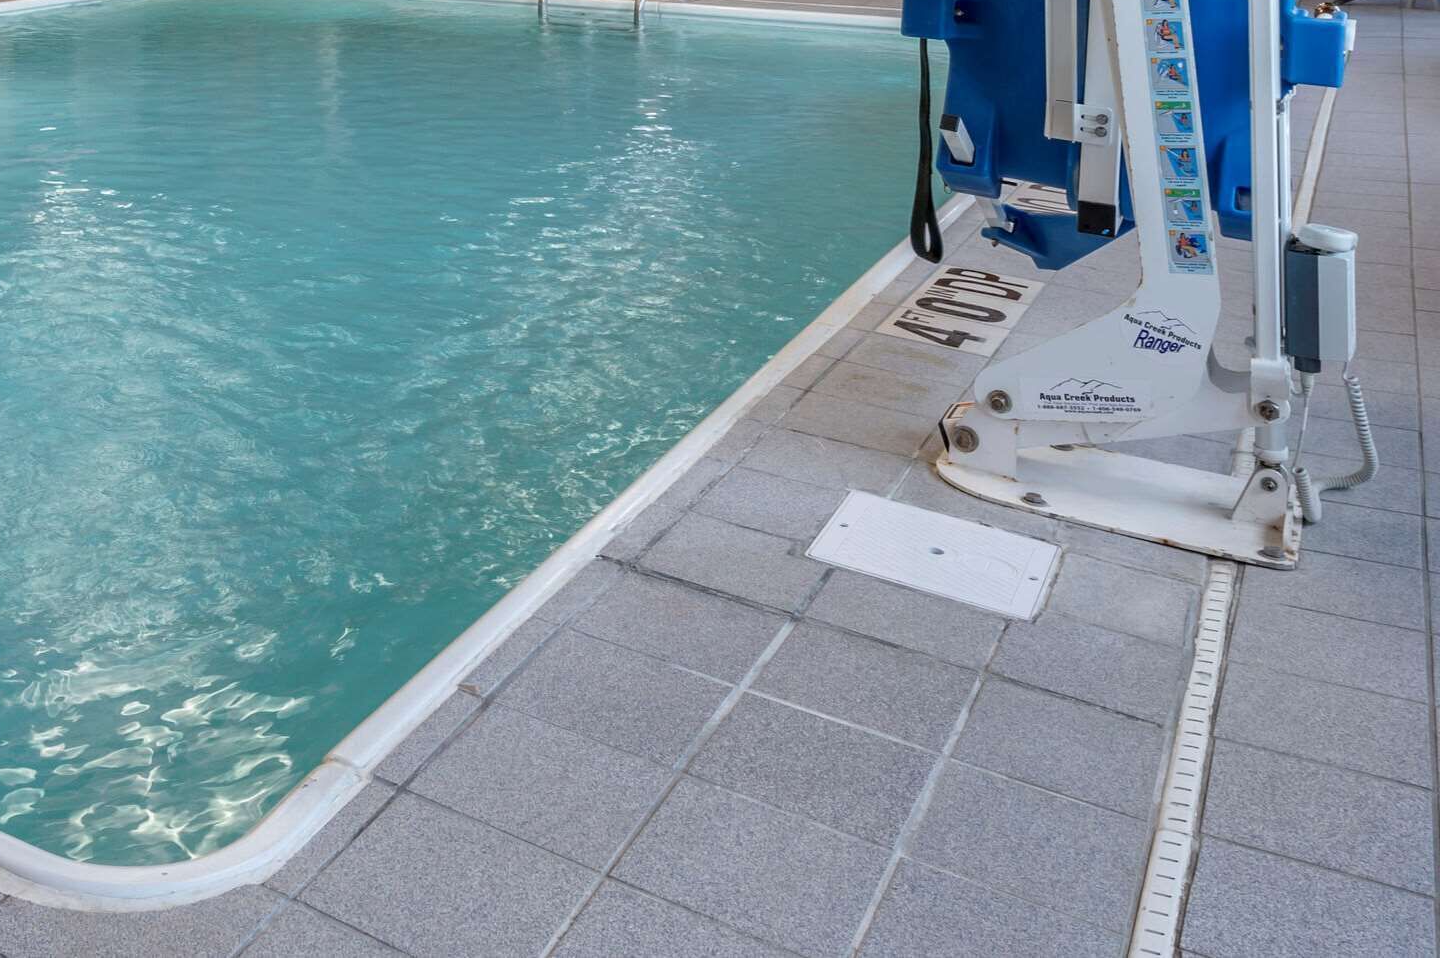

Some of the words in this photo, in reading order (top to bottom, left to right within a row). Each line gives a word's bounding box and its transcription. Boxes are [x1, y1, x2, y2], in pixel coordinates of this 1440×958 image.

[934, 267, 1029, 301] DP
[1123, 313, 1143, 326] Aqua
[1144, 321, 1166, 335] Creek
[1167, 331, 1202, 350] Products
[1133, 329, 1185, 354] Ranger
[1040, 392, 1061, 402] Aqua
[1064, 393, 1091, 402] Creek
[1093, 394, 1136, 403] Products
